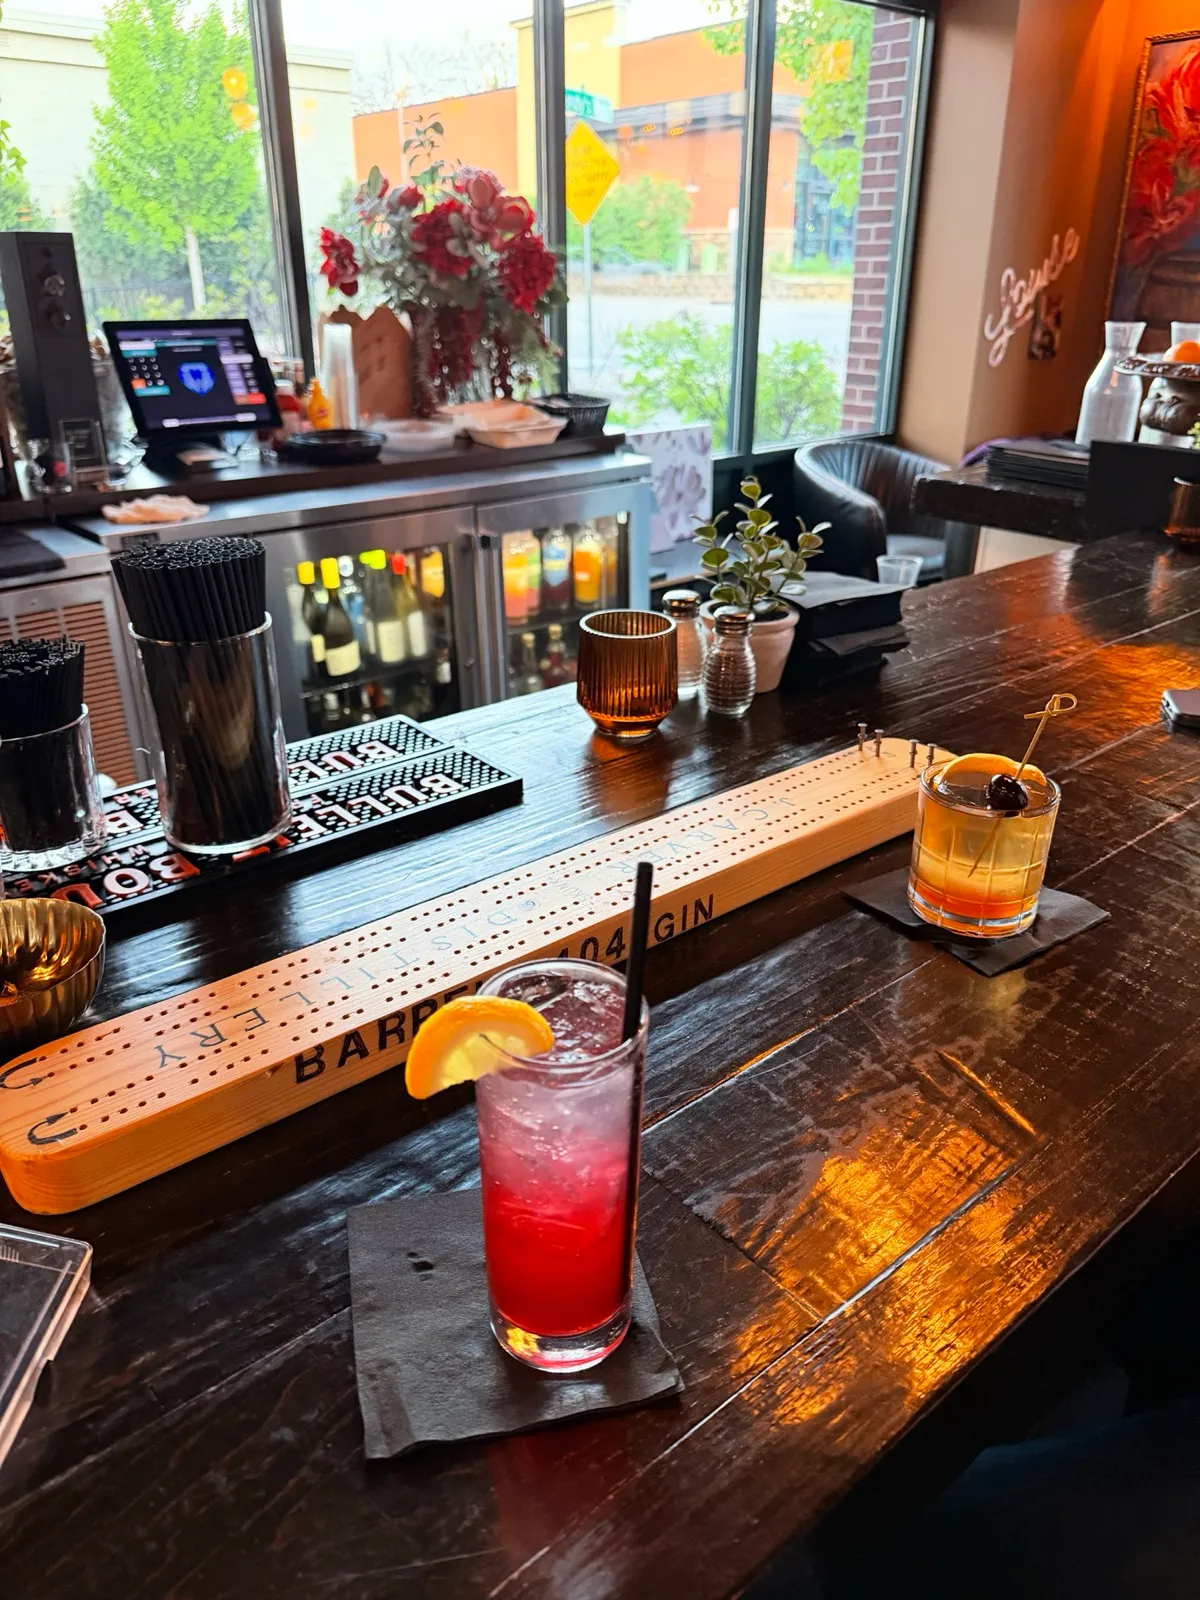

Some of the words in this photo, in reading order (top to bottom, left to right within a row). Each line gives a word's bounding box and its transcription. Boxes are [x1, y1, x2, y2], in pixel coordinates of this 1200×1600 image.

[6, 845, 147, 894] WHISKE
[153, 908, 517, 1069] DISTILLERY
[294, 981, 483, 1084] BARR
[653, 893, 715, 943] GIN
